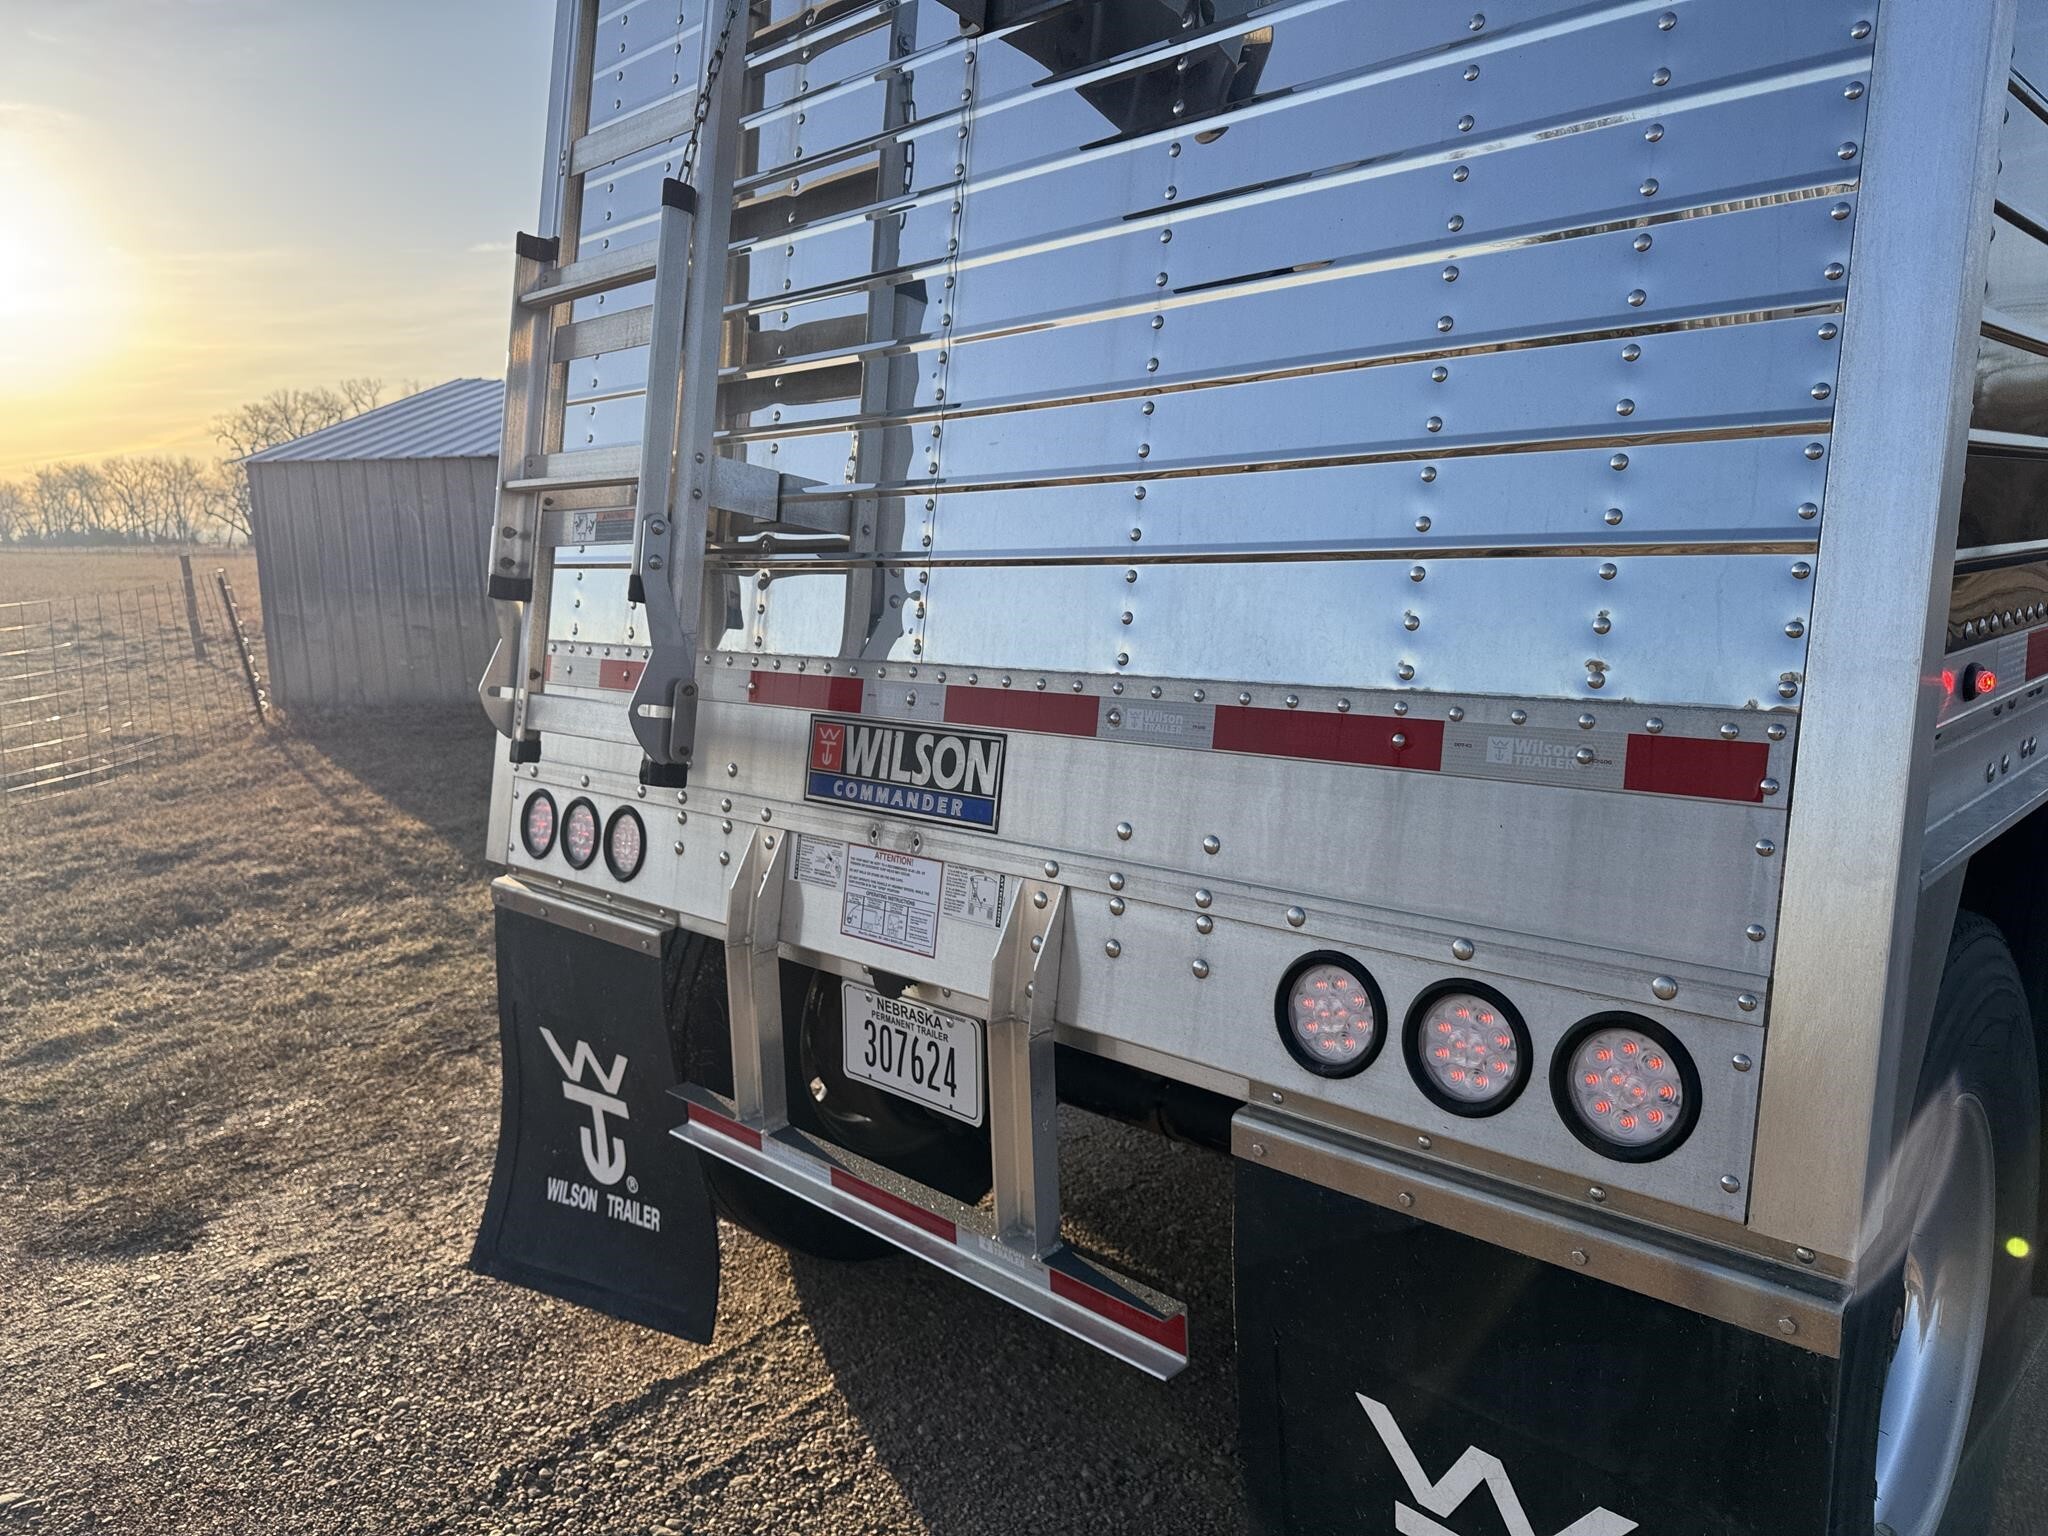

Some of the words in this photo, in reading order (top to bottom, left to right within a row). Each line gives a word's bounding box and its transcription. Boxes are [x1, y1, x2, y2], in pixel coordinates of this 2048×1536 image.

[1144, 708, 1184, 725] Wilson
[846, 725, 1001, 795] WILSON
[1514, 738, 1577, 758] Wilson
[833, 780, 963, 817] COMMANDER
[874, 851, 914, 867] ATTENTION!
[871, 1009, 915, 1032] PERMANENT
[916, 1024, 949, 1043] TRAILER
[876, 997, 943, 1031] NEBRASKA
[864, 1019, 957, 1098] 307624
[547, 1176, 599, 1213] WILSON
[606, 1193, 660, 1232] TRAILER
